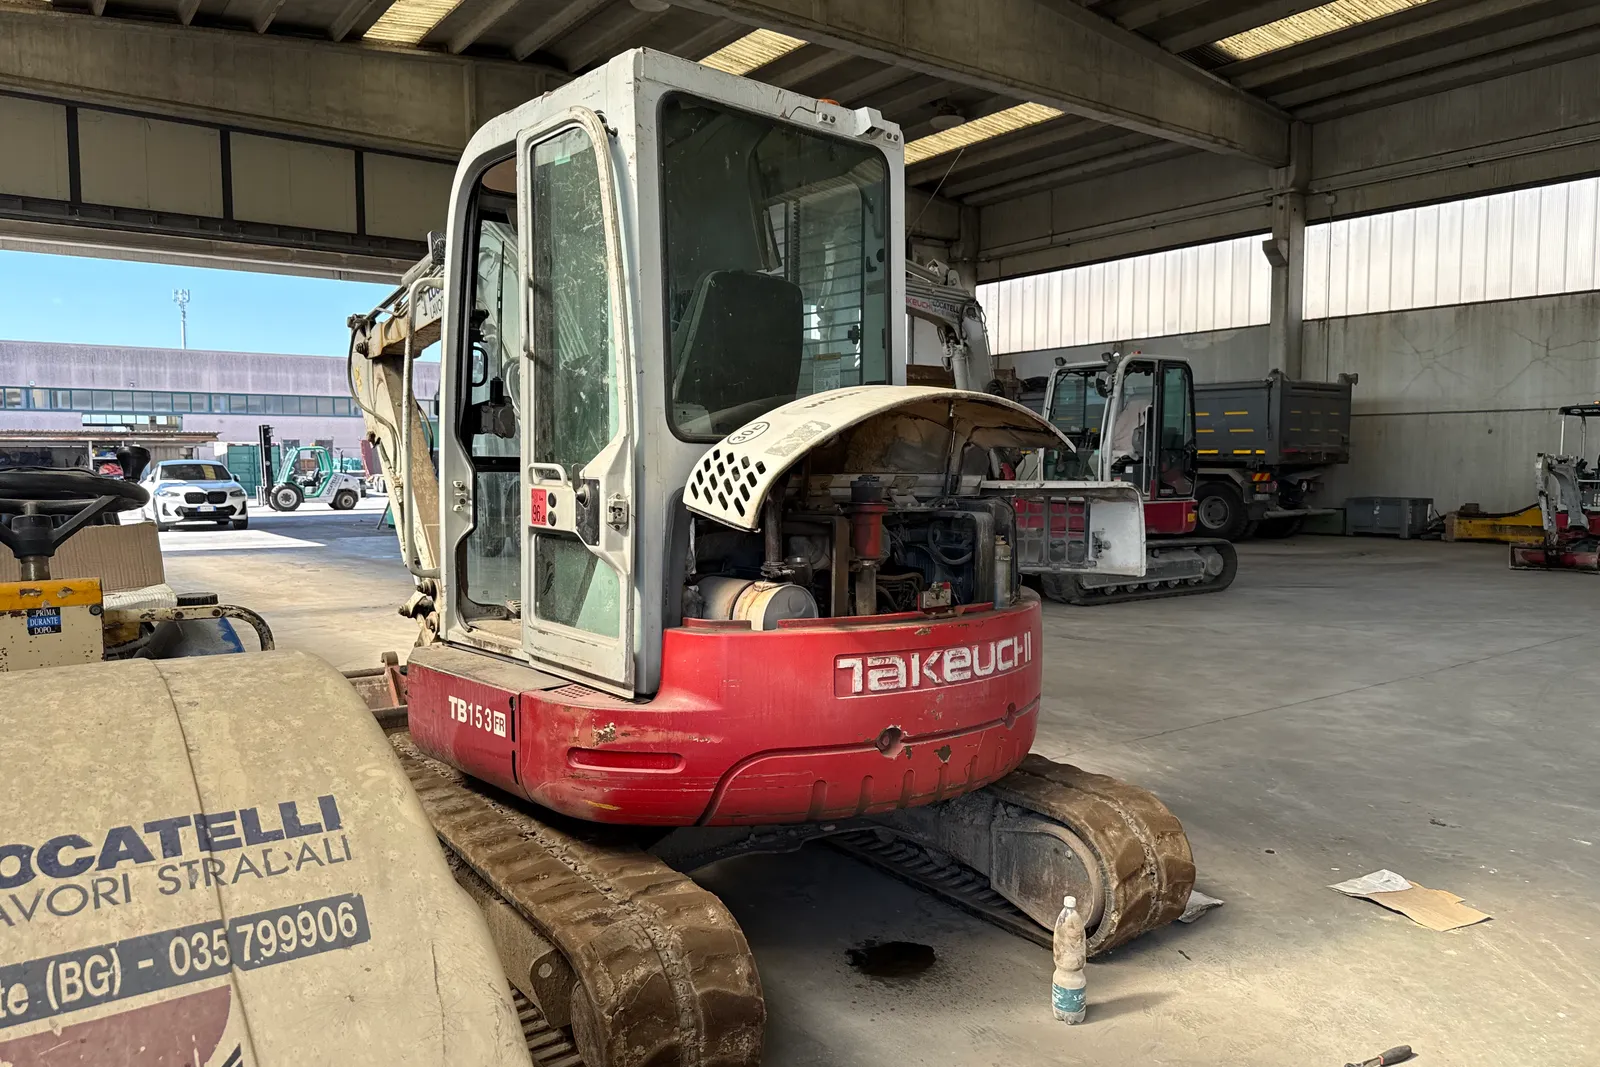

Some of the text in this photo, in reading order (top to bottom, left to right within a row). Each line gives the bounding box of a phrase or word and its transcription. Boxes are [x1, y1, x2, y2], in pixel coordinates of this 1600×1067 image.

[533, 504, 540, 522] 96
[30, 617, 58, 626] DURANTE
[158, 835, 352, 895] STRADALI
[46, 948, 122, 1010] (BG)
